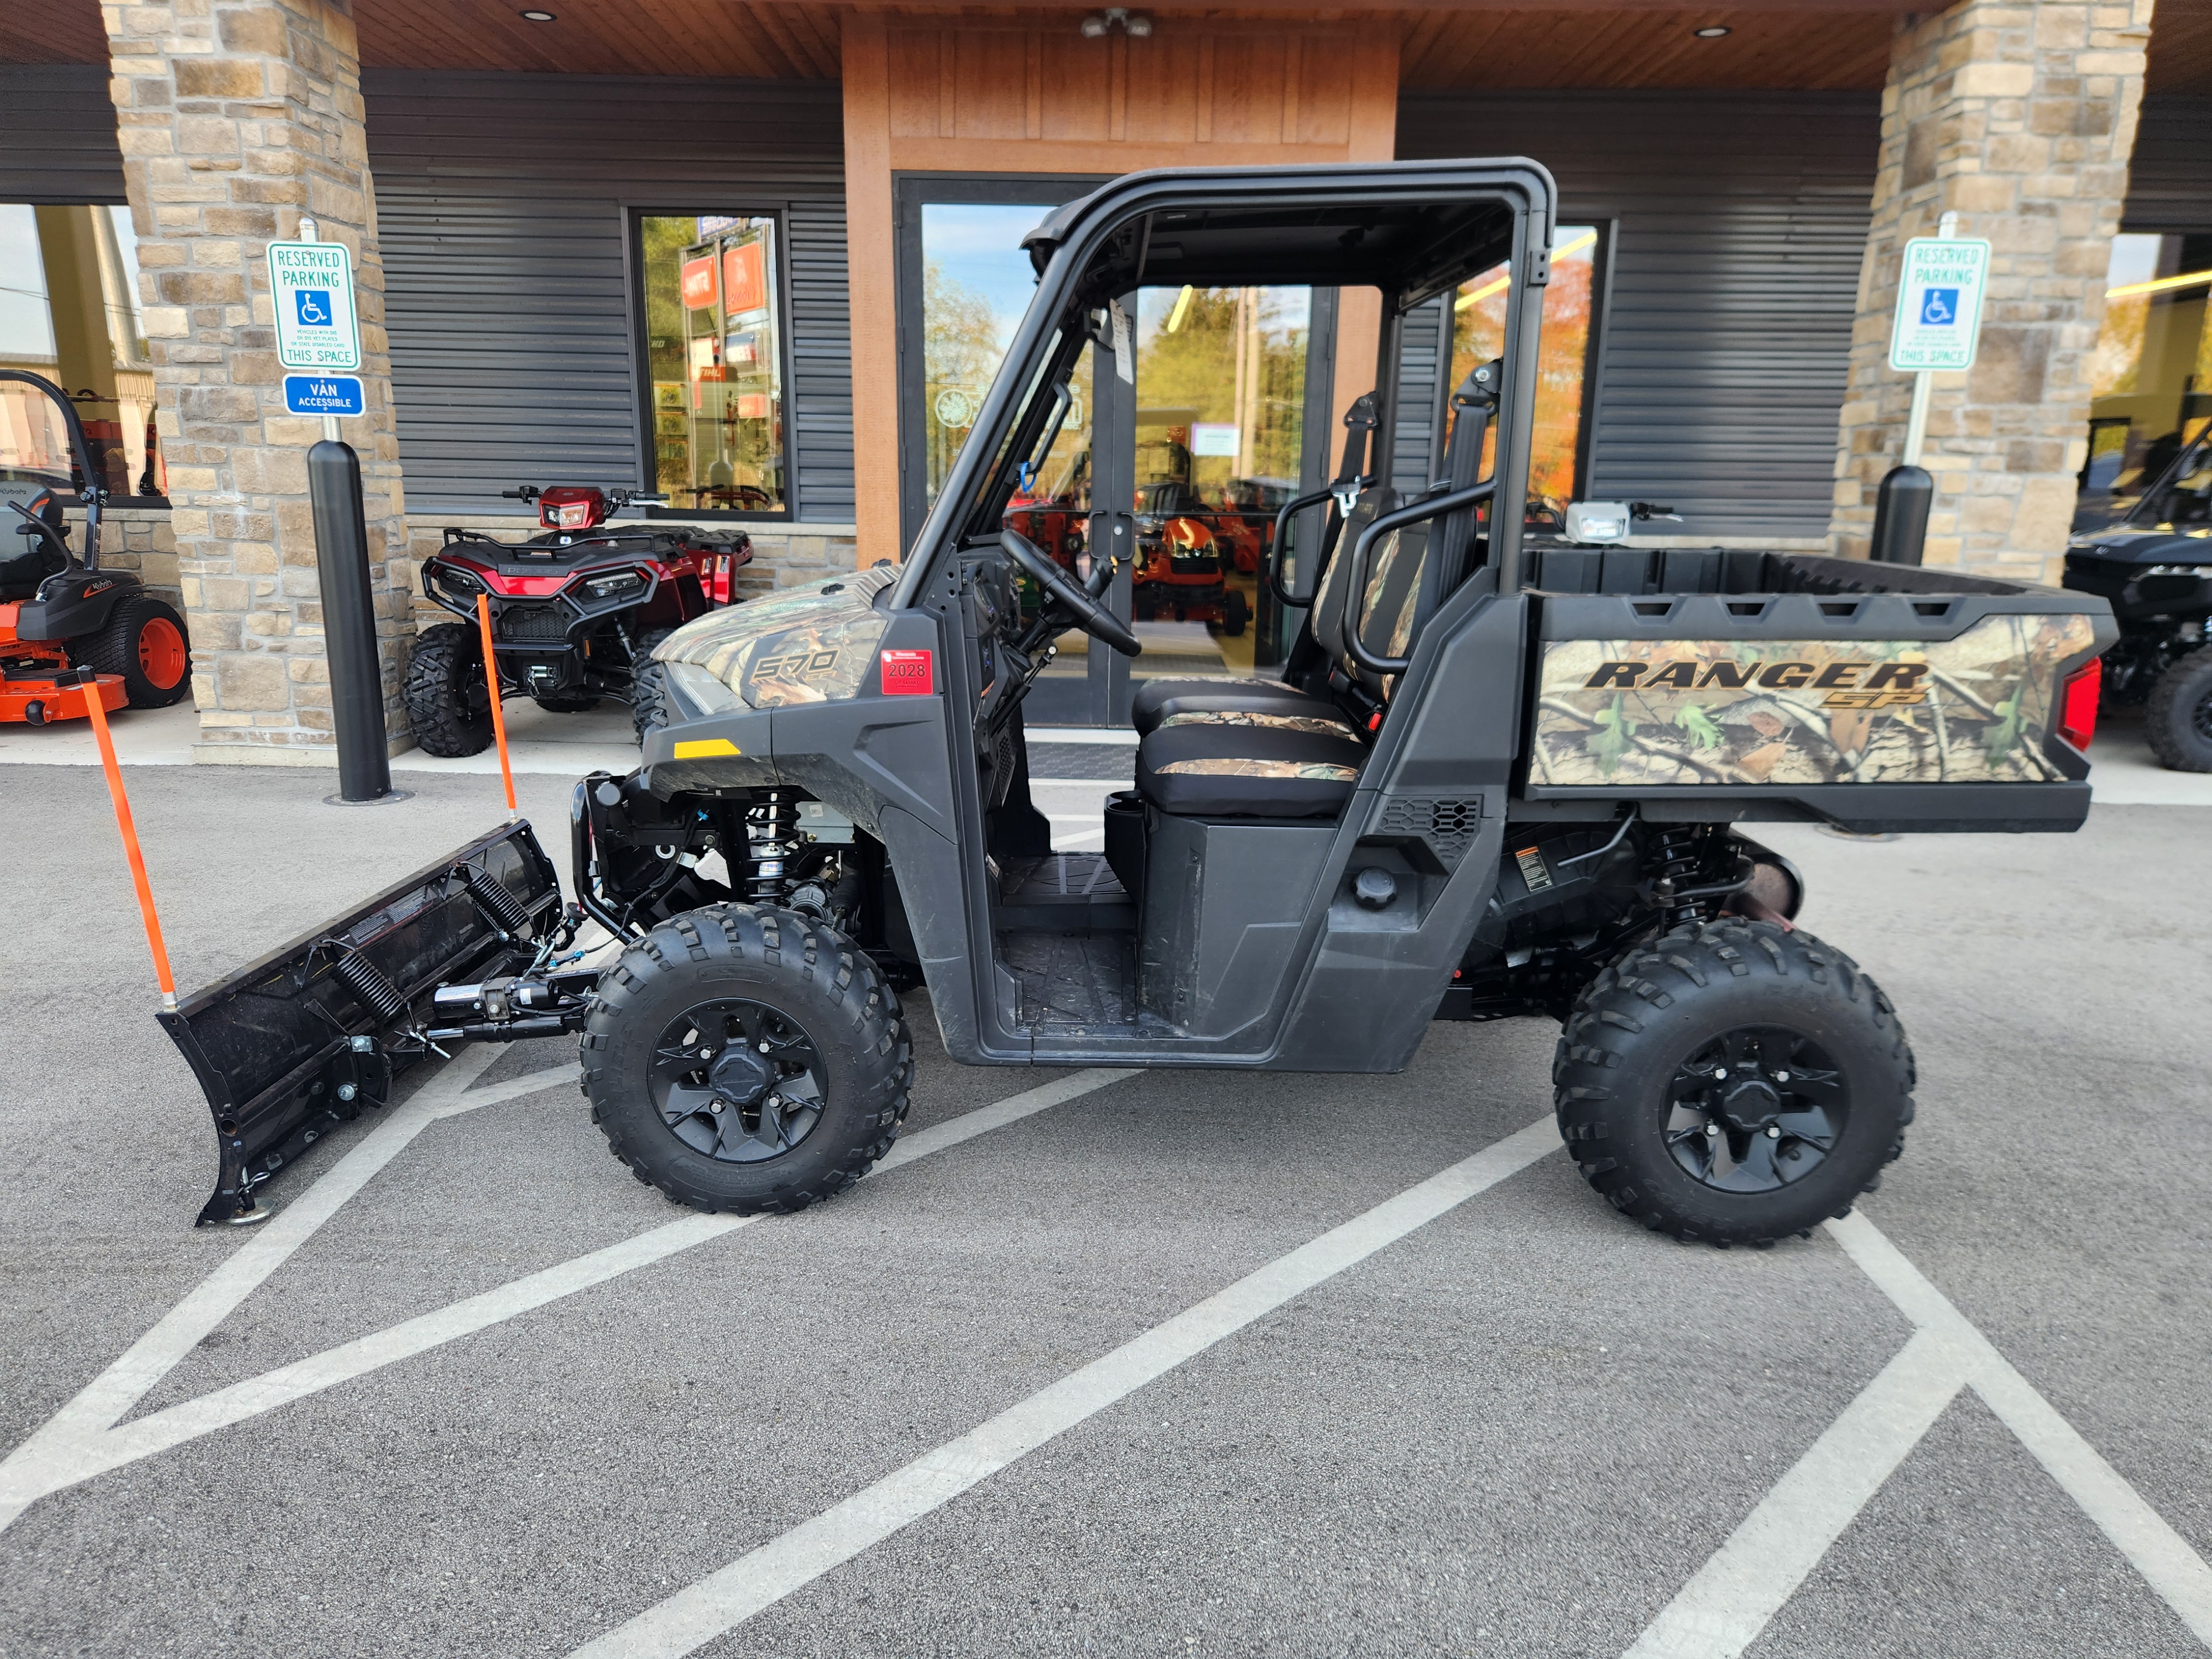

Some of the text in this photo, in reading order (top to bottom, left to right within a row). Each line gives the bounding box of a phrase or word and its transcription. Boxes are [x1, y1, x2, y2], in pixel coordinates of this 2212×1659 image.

[278, 251, 340, 267] RESERVED
[1914, 247, 1979, 264] RESERVED
[283, 270, 339, 287] PARKING
[1914, 268, 1973, 285] PARKING
[287, 349, 352, 363] THIS SPACE
[1901, 349, 1965, 362] THIS SPACE
[700, 368, 721, 377] TIHL
[310, 384, 337, 397] VAN
[298, 398, 352, 408] ACCESSIBLE
[92, 578, 113, 590] Kubota
[750, 649, 839, 685] 570
[889, 664, 926, 677] 2028
[805, 671, 836, 681] EFI
[1584, 661, 1931, 691] RANGER
[1818, 692, 1927, 709] SP
